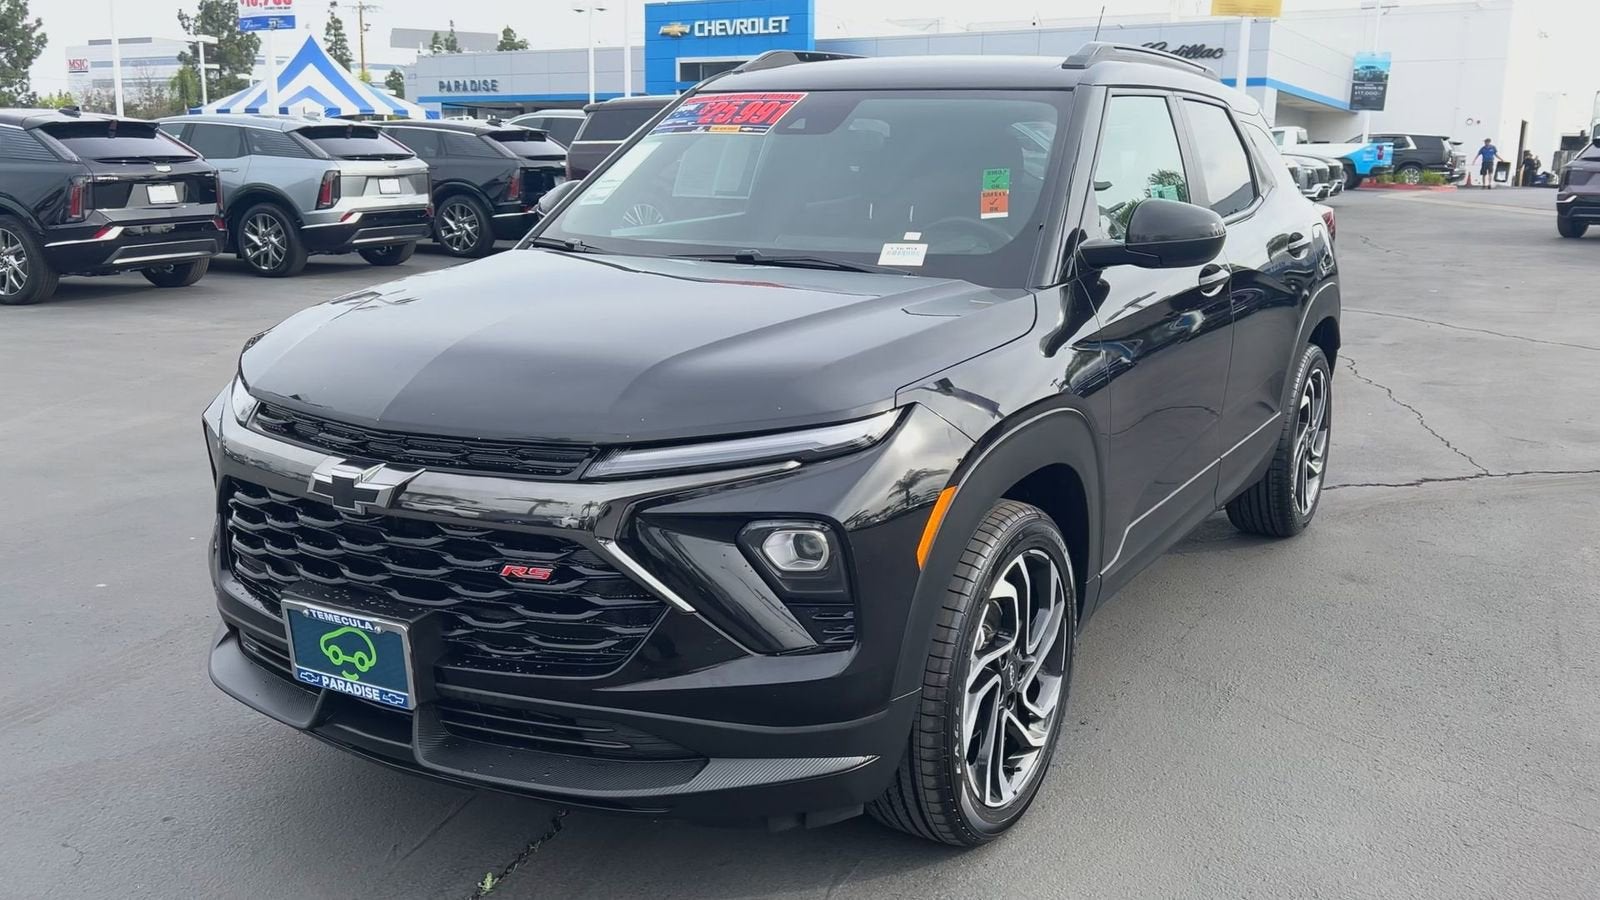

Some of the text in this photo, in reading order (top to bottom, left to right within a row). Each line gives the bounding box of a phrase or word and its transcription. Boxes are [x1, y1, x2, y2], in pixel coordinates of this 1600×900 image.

[694, 16, 790, 37] CHEVROLET
[1141, 41, 1224, 60] Cdillac
[438, 79, 499, 92] PARADISE
[500, 565, 553, 580] RS
[309, 609, 374, 632] TEMECULA
[321, 675, 381, 701] PARADISE
